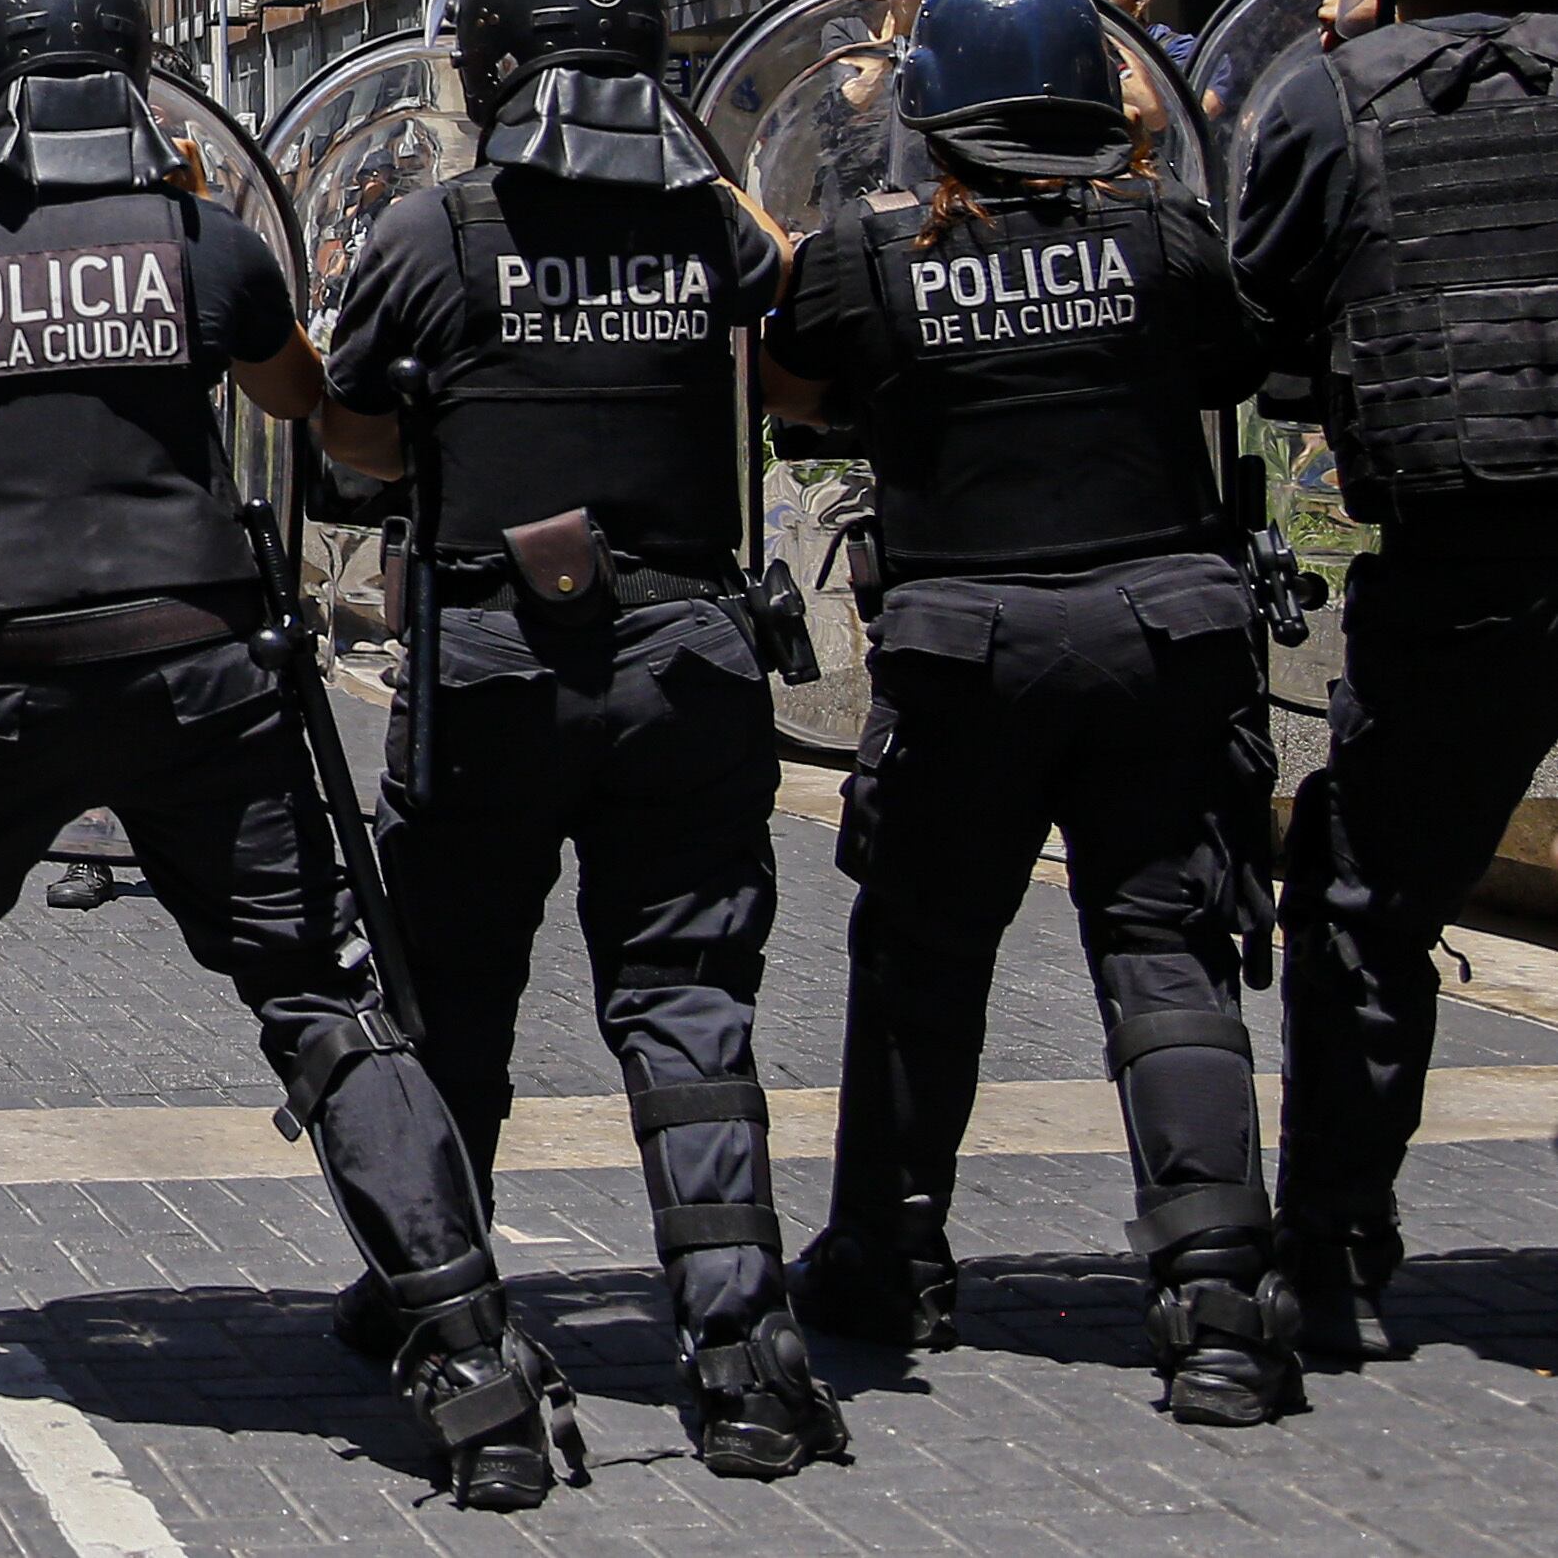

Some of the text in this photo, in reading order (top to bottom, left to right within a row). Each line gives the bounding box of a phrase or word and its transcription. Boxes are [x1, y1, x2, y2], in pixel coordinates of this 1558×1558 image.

[496, 253, 712, 307] POLICIA
[910, 238, 1134, 311] POLICIA
[42, 318, 179, 363] CIUDAD
[501, 310, 709, 343] DE LA CIUDAD
[919, 294, 1135, 347] DE LA CIUDAD
